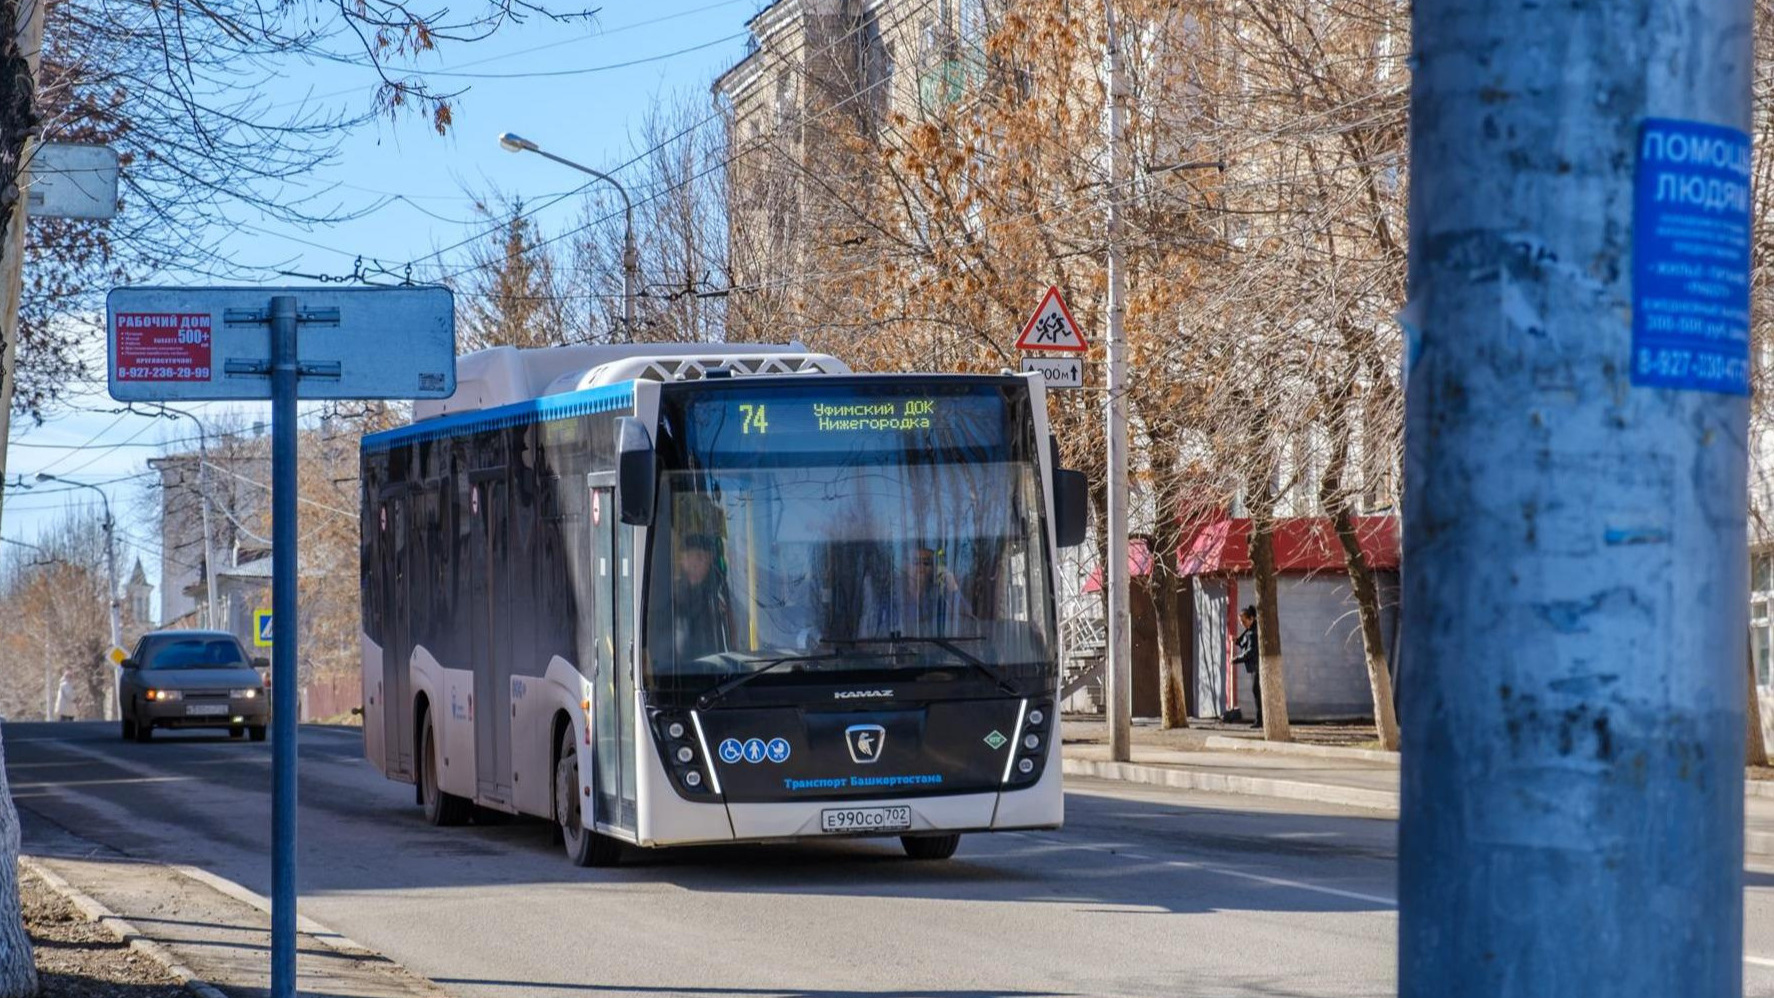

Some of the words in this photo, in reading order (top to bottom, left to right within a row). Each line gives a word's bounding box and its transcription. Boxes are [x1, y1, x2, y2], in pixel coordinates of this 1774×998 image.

[1643, 131, 1750, 175] ПОМОЩ
[118, 315, 178, 328] РАБОЧИЙ
[180, 316, 210, 329] ДОМ
[178, 329, 210, 344] 500+
[813, 403, 894, 417] Уфимский
[904, 400, 935, 415] ДОК
[739, 404, 769, 434] 74
[819, 417, 930, 431] Нижегородка
[834, 689, 894, 699] KAMAZ
[784, 777, 847, 790] Транспорт
[850, 774, 943, 787] Башкортостана
[885, 808, 906, 820] 702
